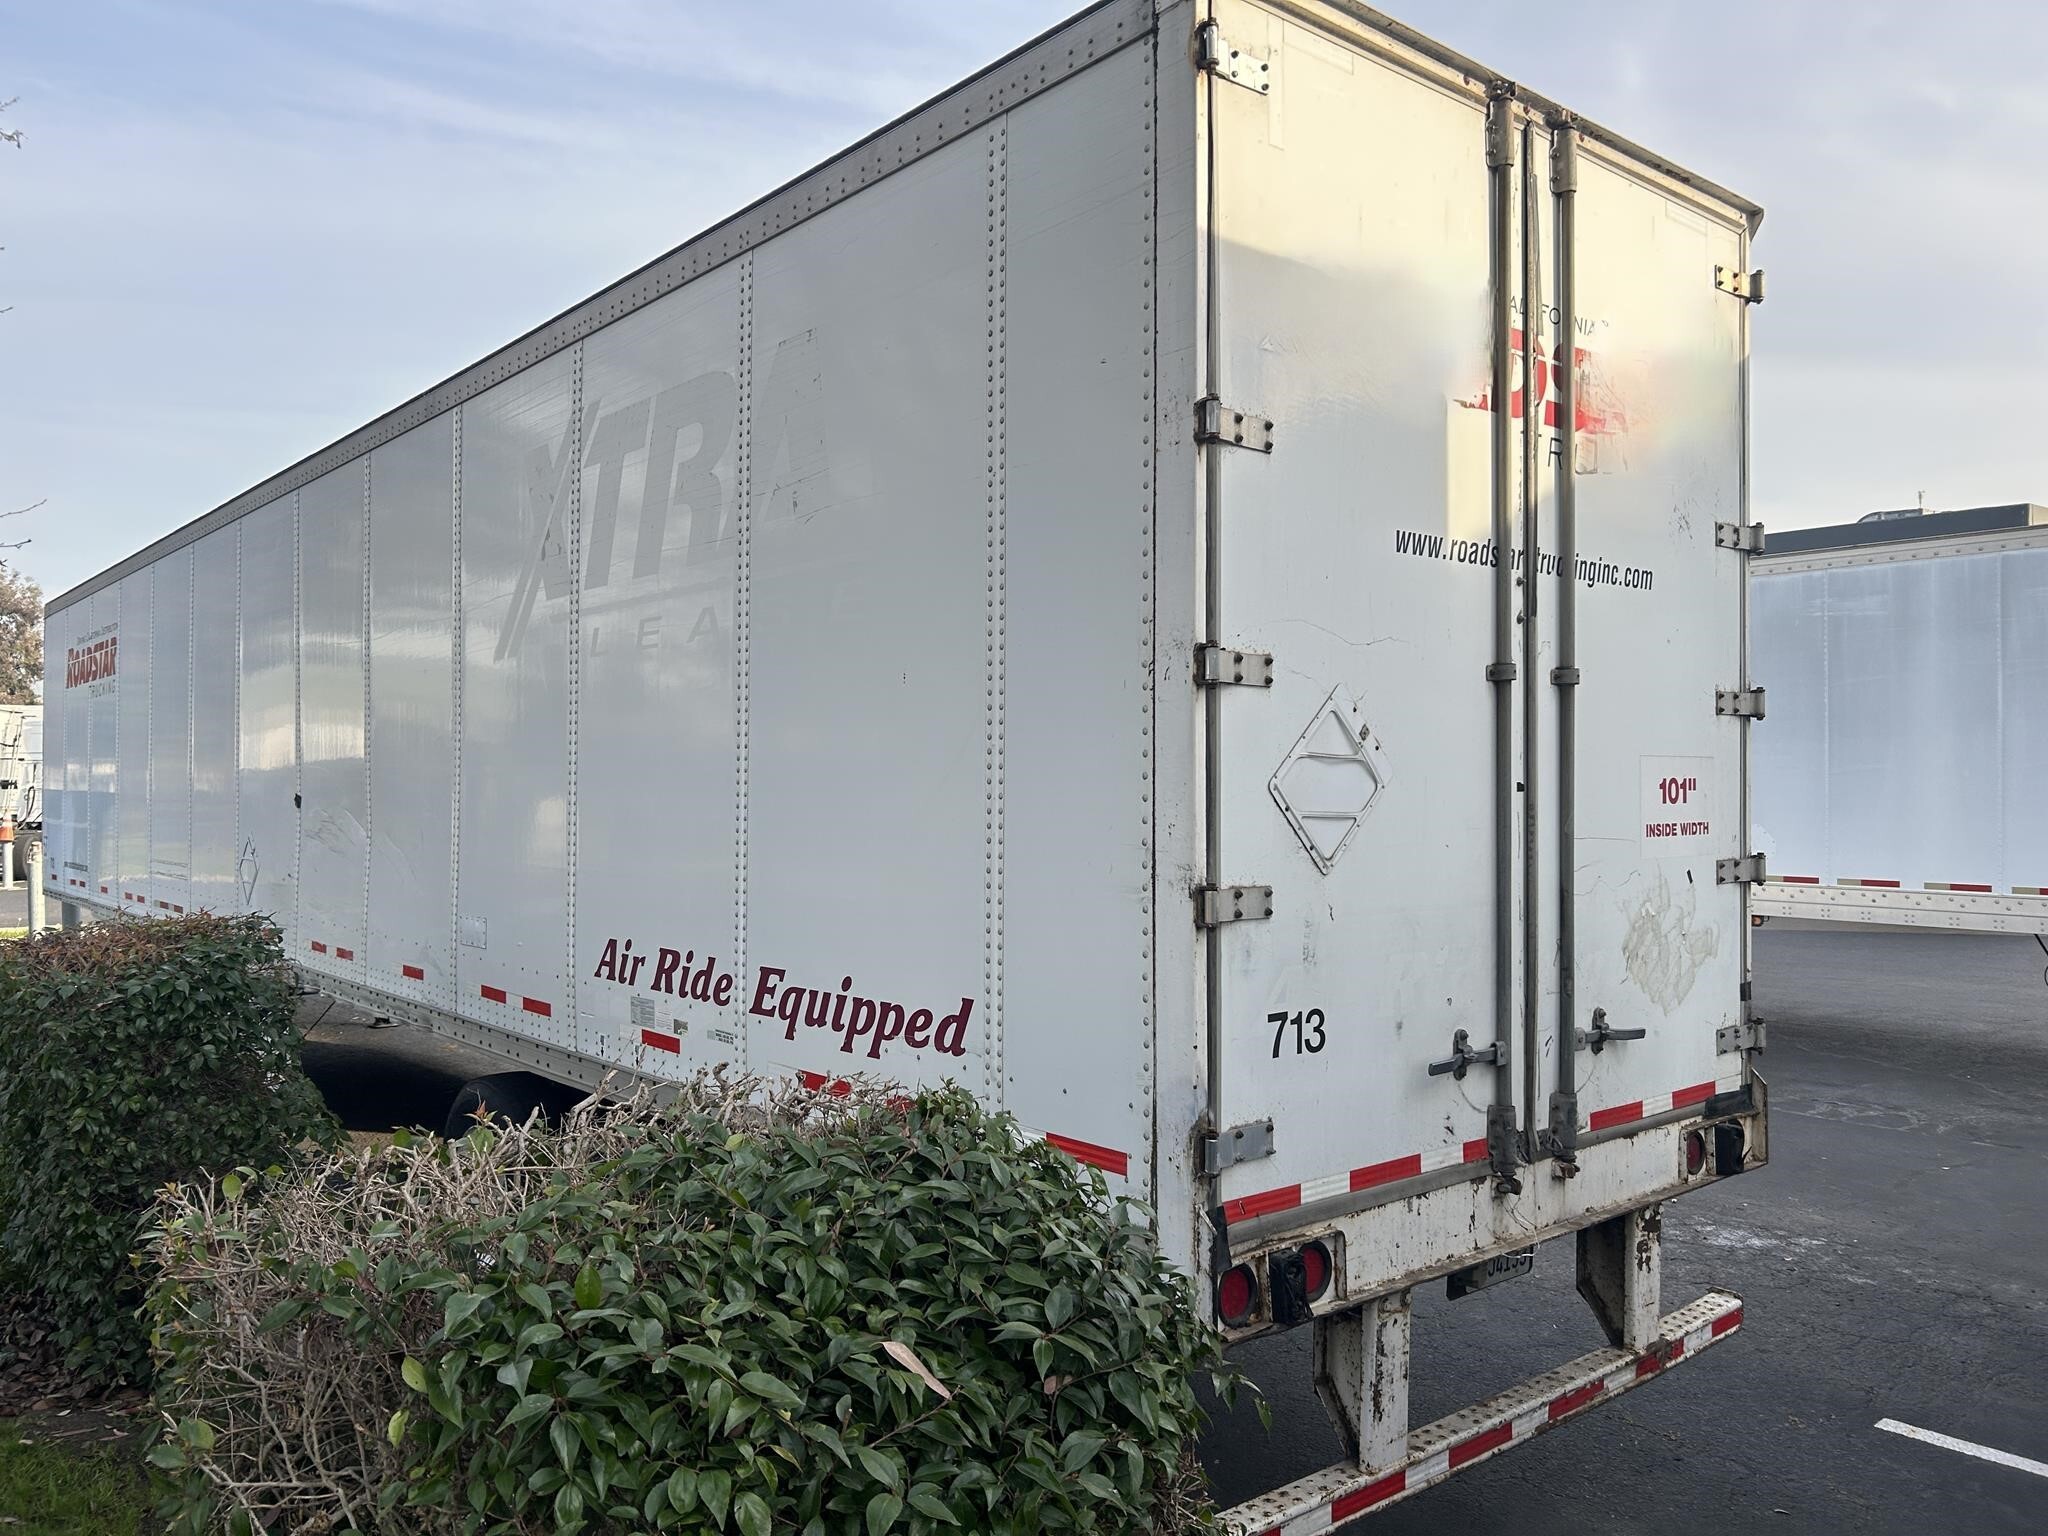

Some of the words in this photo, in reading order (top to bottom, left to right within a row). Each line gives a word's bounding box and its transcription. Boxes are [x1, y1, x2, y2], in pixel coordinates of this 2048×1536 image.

[66, 636, 117, 690] ROADSTAR
[1659, 777, 1697, 804] 101"
[1646, 823, 1677, 837] INSIDE
[1681, 822, 1709, 836] WIDTH
[594, 938, 646, 988] Air
[650, 947, 734, 1007] Ride
[748, 965, 975, 1060] Equipped
[1267, 1008, 1326, 1058] 713
